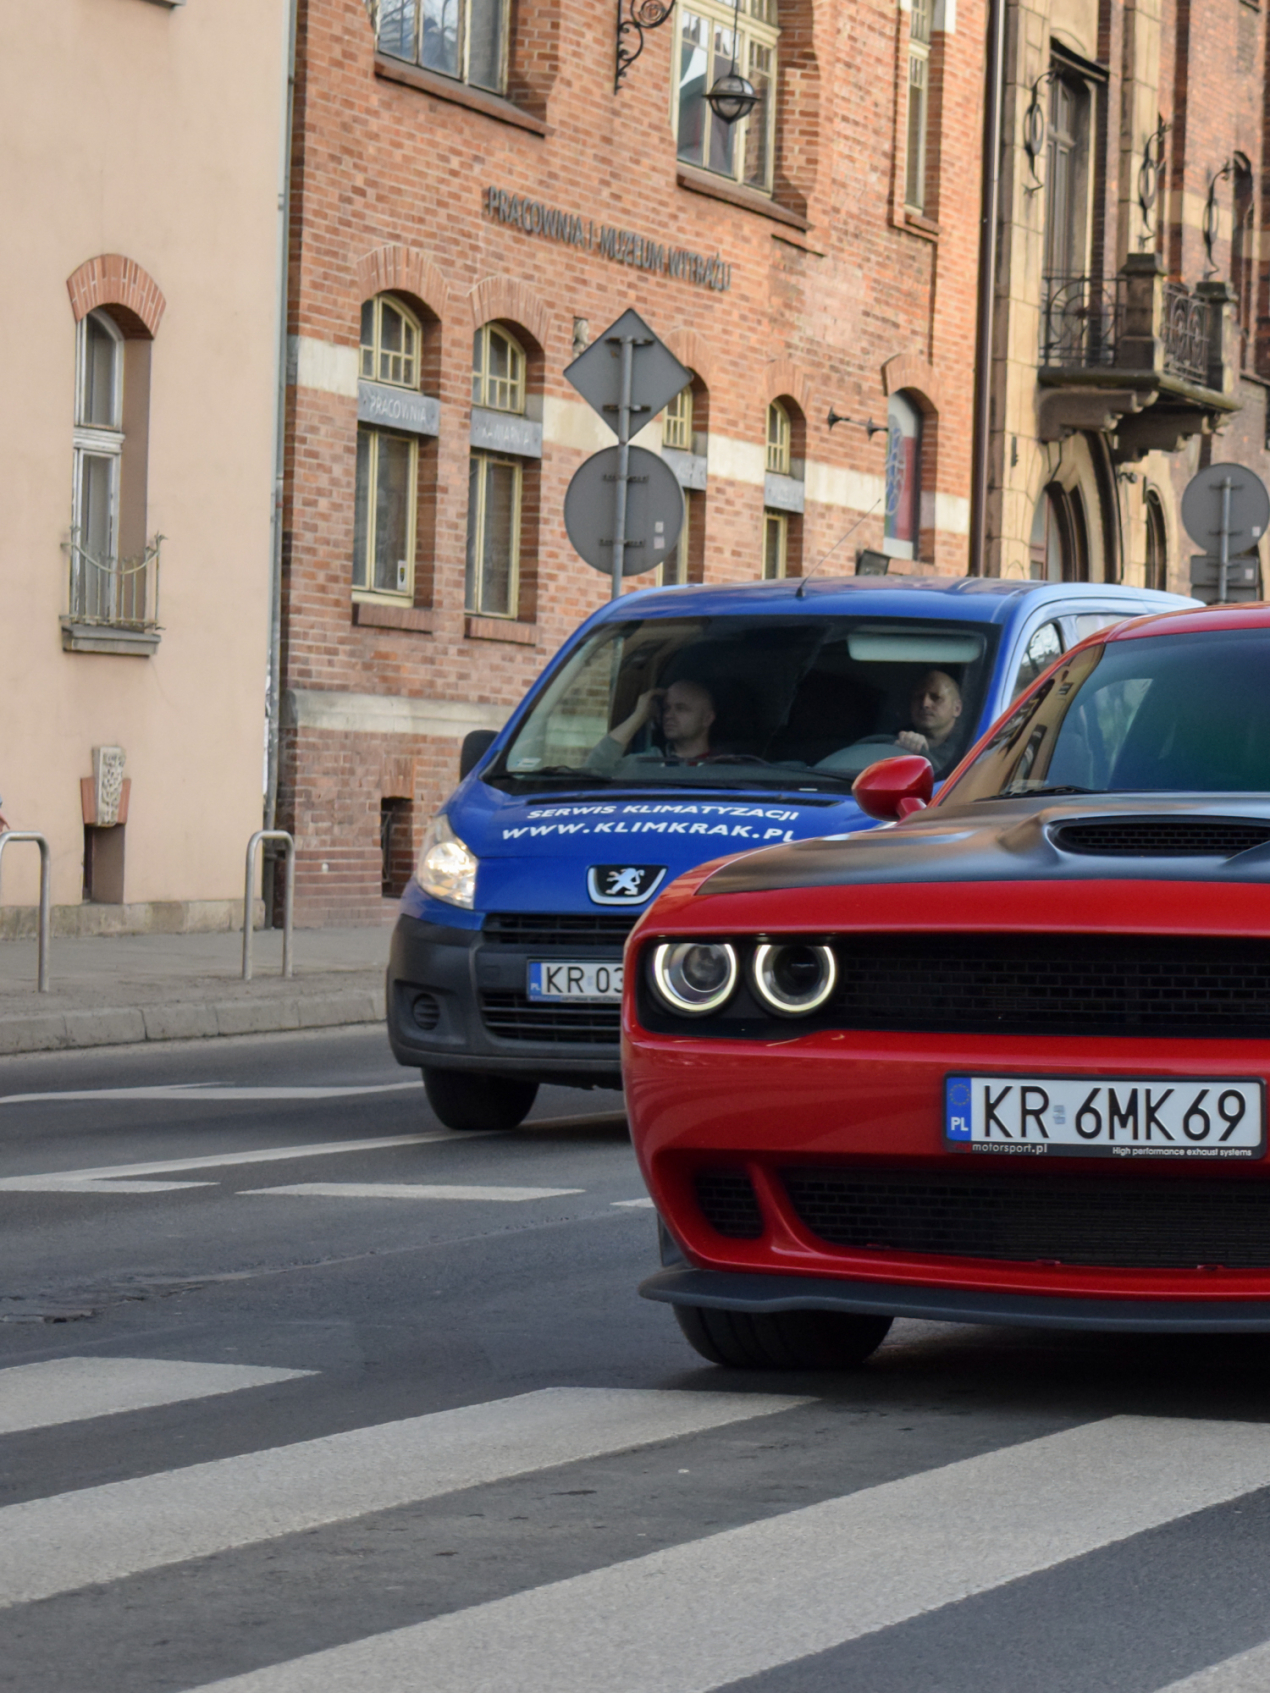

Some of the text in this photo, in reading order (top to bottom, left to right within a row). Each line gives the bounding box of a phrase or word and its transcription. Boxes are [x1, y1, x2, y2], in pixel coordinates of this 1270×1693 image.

[485, 185, 585, 248] PRACOWNIA
[587, 220, 594, 250] I
[600, 225, 664, 273] MUZEUM
[370, 395, 426, 423] PRACOWNIA
[527, 804, 799, 821] SERWIS KLIMATYZACJI
[503, 822, 795, 843] WWW.KLIMKRAK.PL
[530, 982, 541, 991] PL
[547, 966, 585, 993] KR
[951, 1117, 969, 1131] PL
[984, 1085, 1247, 1142] KR 6MK69
[1112, 1146, 1252, 1158] High performance exhaust systems
